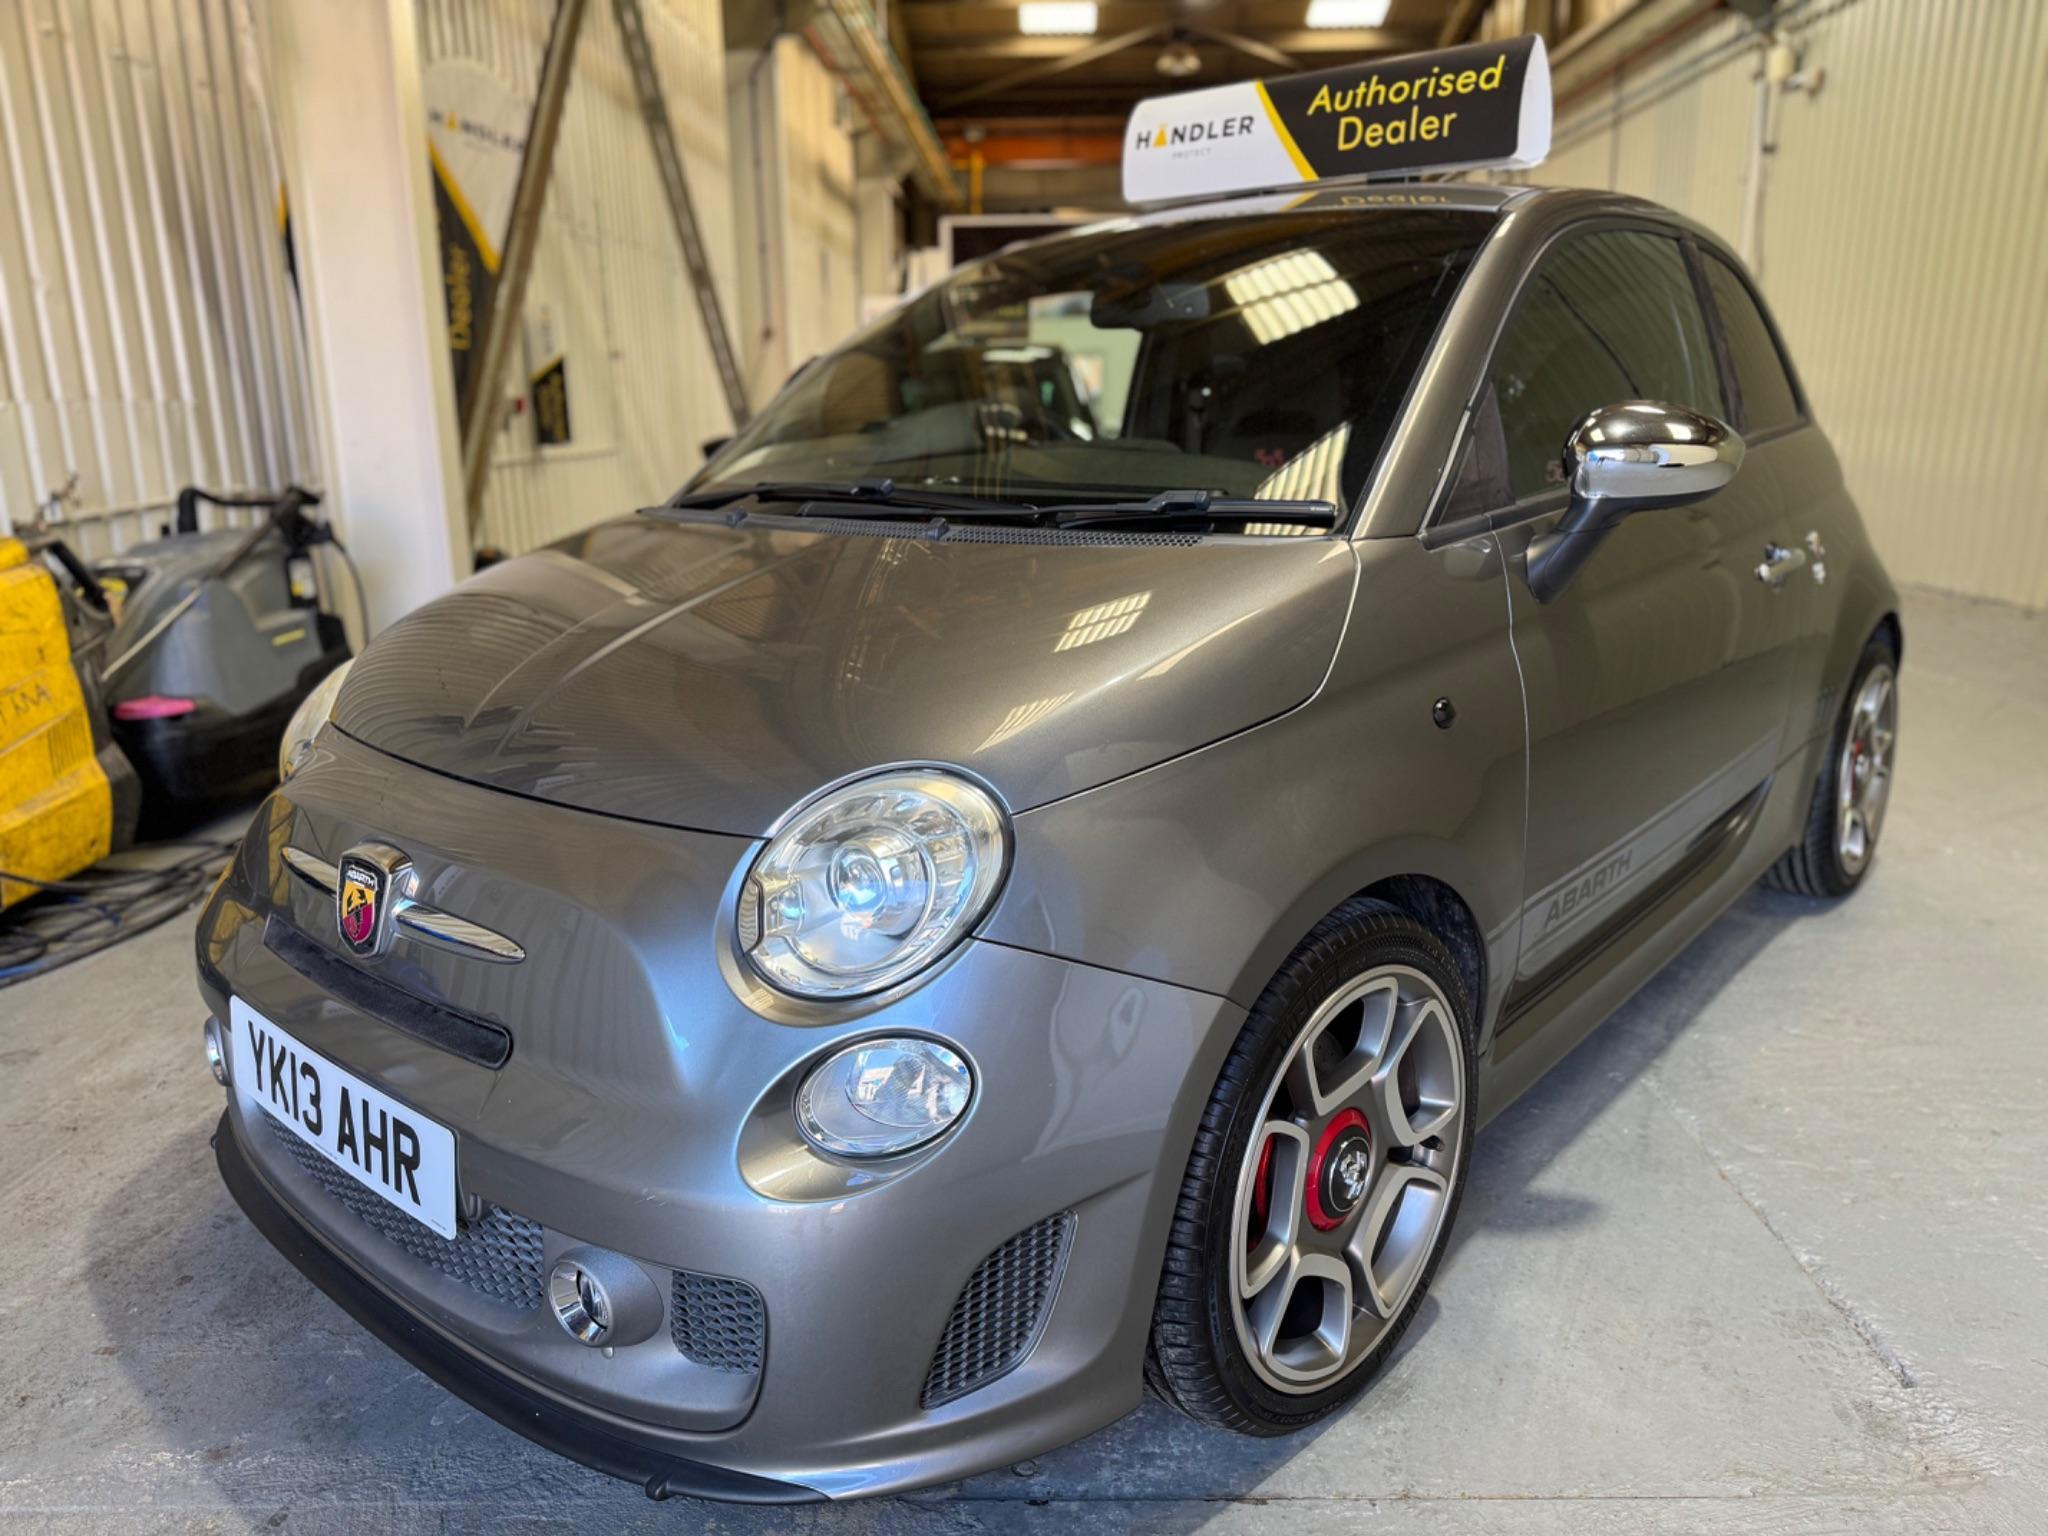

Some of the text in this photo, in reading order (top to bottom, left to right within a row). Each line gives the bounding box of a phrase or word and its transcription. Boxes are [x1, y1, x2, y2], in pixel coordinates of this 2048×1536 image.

[1306, 53, 1507, 116] Authorised
[1337, 104, 1458, 152] Dealer
[1543, 848, 1633, 930] ABARTH
[247, 1020, 422, 1207] YK13 AHR
